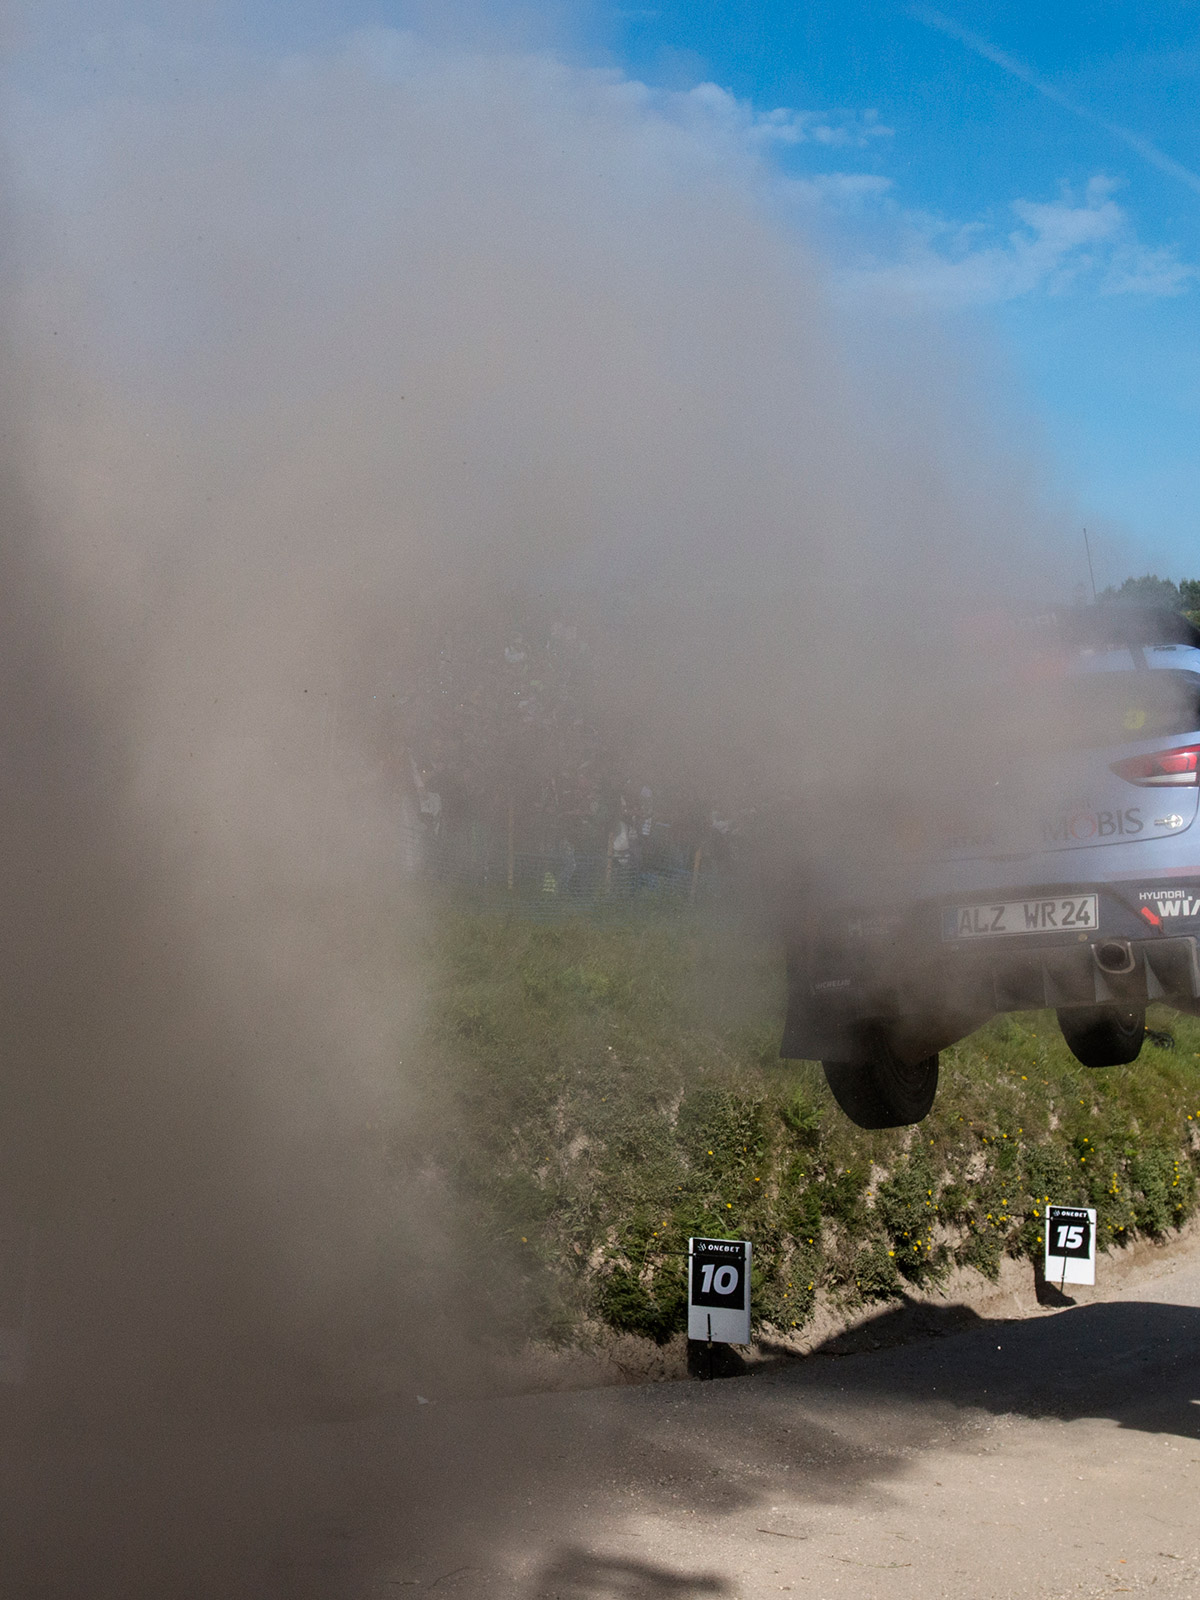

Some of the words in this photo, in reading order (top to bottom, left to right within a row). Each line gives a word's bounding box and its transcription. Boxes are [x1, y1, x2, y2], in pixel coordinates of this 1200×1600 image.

[1042, 807, 1144, 841] MOBIS
[1139, 890, 1185, 900] HYUNDAI
[958, 905, 1007, 934] ALZ
[1061, 1210, 1088, 1218] ONEBET
[707, 1244, 740, 1253] ONEBET
[1057, 1225, 1085, 1249] 15
[701, 1264, 739, 1295] 10
